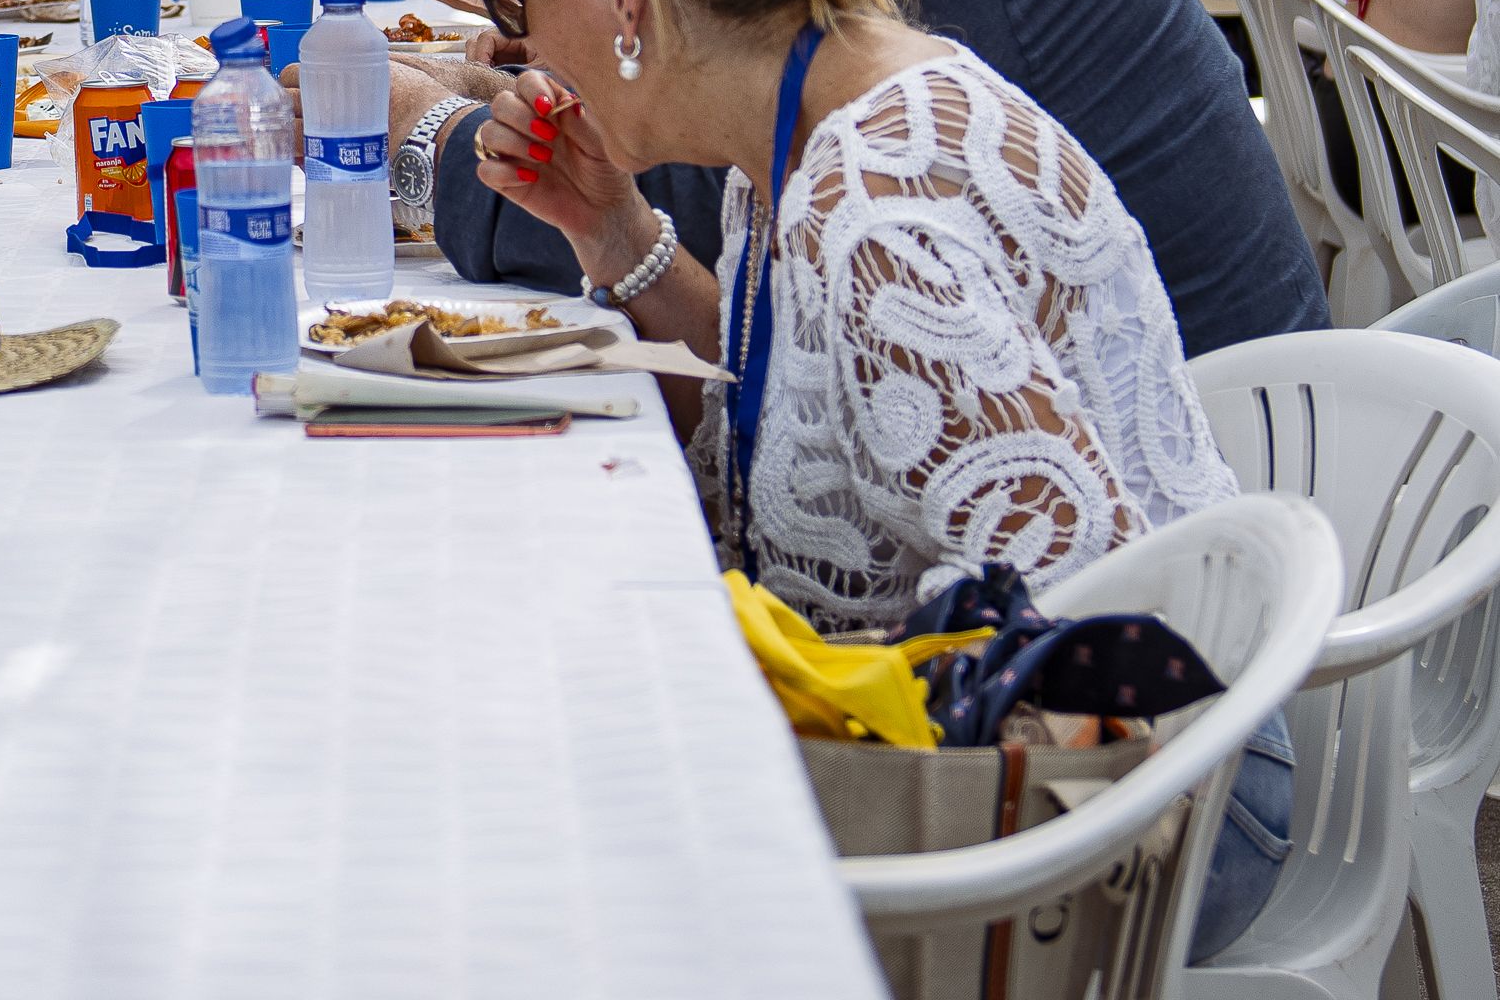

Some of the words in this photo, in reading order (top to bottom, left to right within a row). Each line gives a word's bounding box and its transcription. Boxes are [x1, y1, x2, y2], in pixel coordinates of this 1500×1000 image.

[340, 147, 361, 157] Font
[95, 158, 122, 167] naranja
[339, 156, 362, 166] Vella
